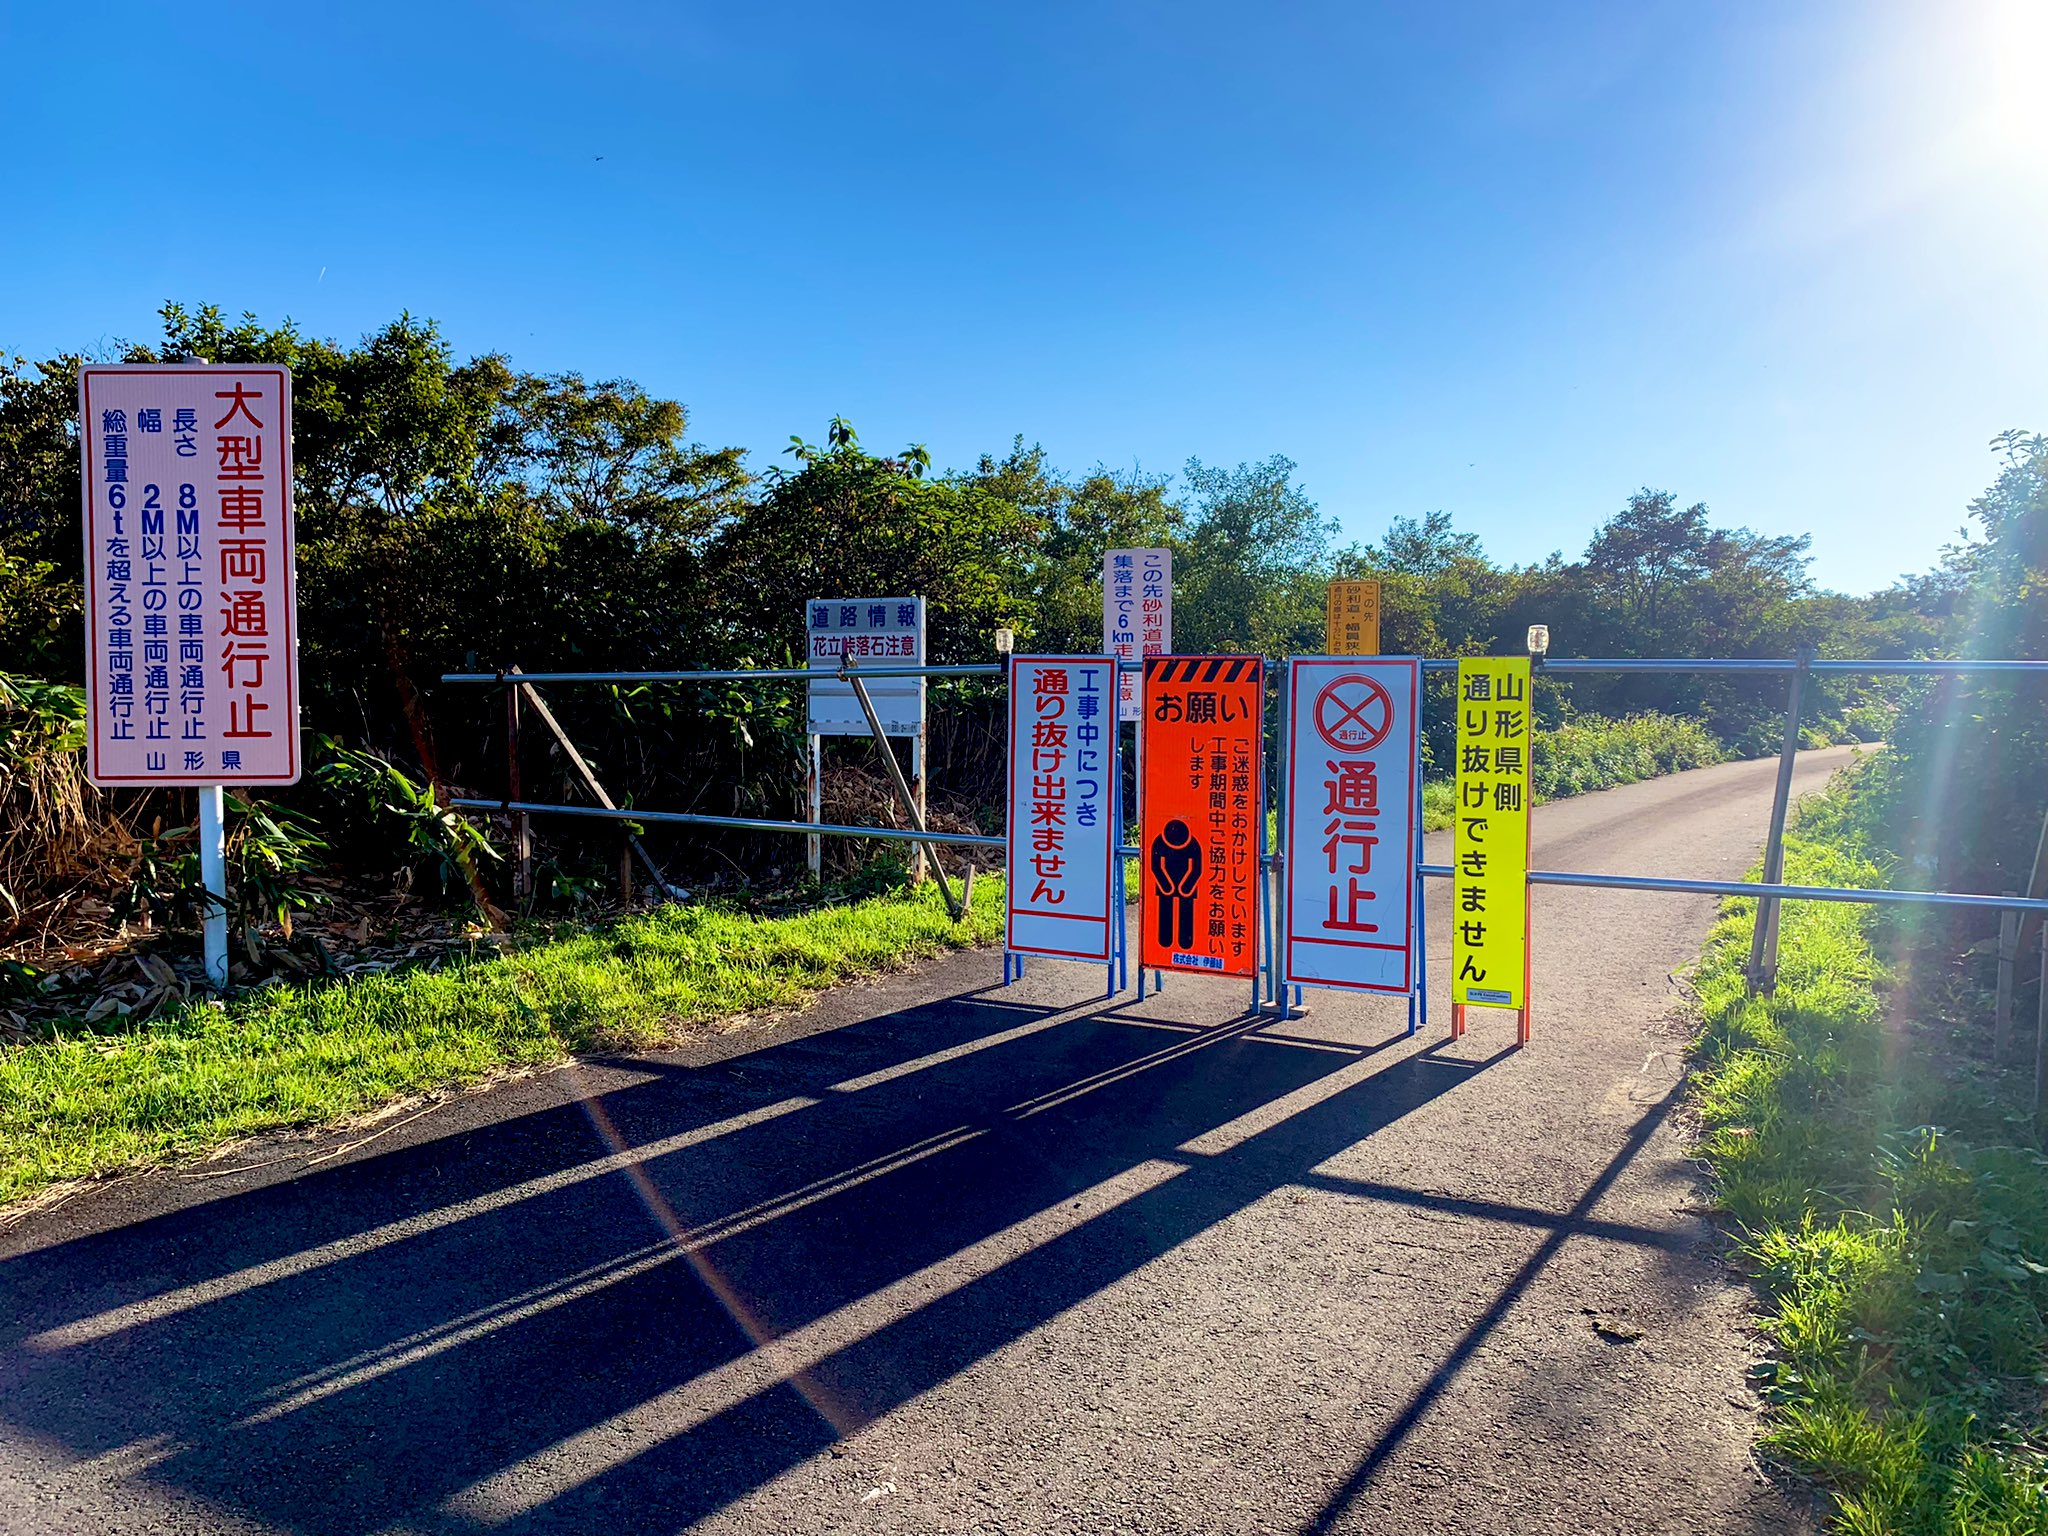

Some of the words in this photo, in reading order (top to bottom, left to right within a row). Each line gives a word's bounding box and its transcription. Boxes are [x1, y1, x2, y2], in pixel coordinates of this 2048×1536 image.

[101, 408, 135, 741] 総重量6tを超える車両通行止
[214, 381, 272, 738] 大型車両通行止
[812, 604, 916, 628] 道路情報
[1364, 585, 1374, 622] この先
[813, 635, 915, 657] 花立峠落石注意
[1154, 692, 1249, 724] お願い
[147, 752, 242, 771] 山形県
[1029, 668, 1069, 905] 通り抜け出来ません
[1075, 669, 1100, 827] 工事中につき
[1189, 737, 1205, 789] します
[1338, 729, 1368, 741] 通行止
[1493, 673, 1523, 812] 山形県側
[1208, 738, 1227, 954] 工事期間中ご協力をお願い
[1231, 738, 1250, 957] ご迷惑をおかけしています
[1322, 759, 1380, 933] 通行止
[1458, 673, 1491, 983] 通り抜けできません
